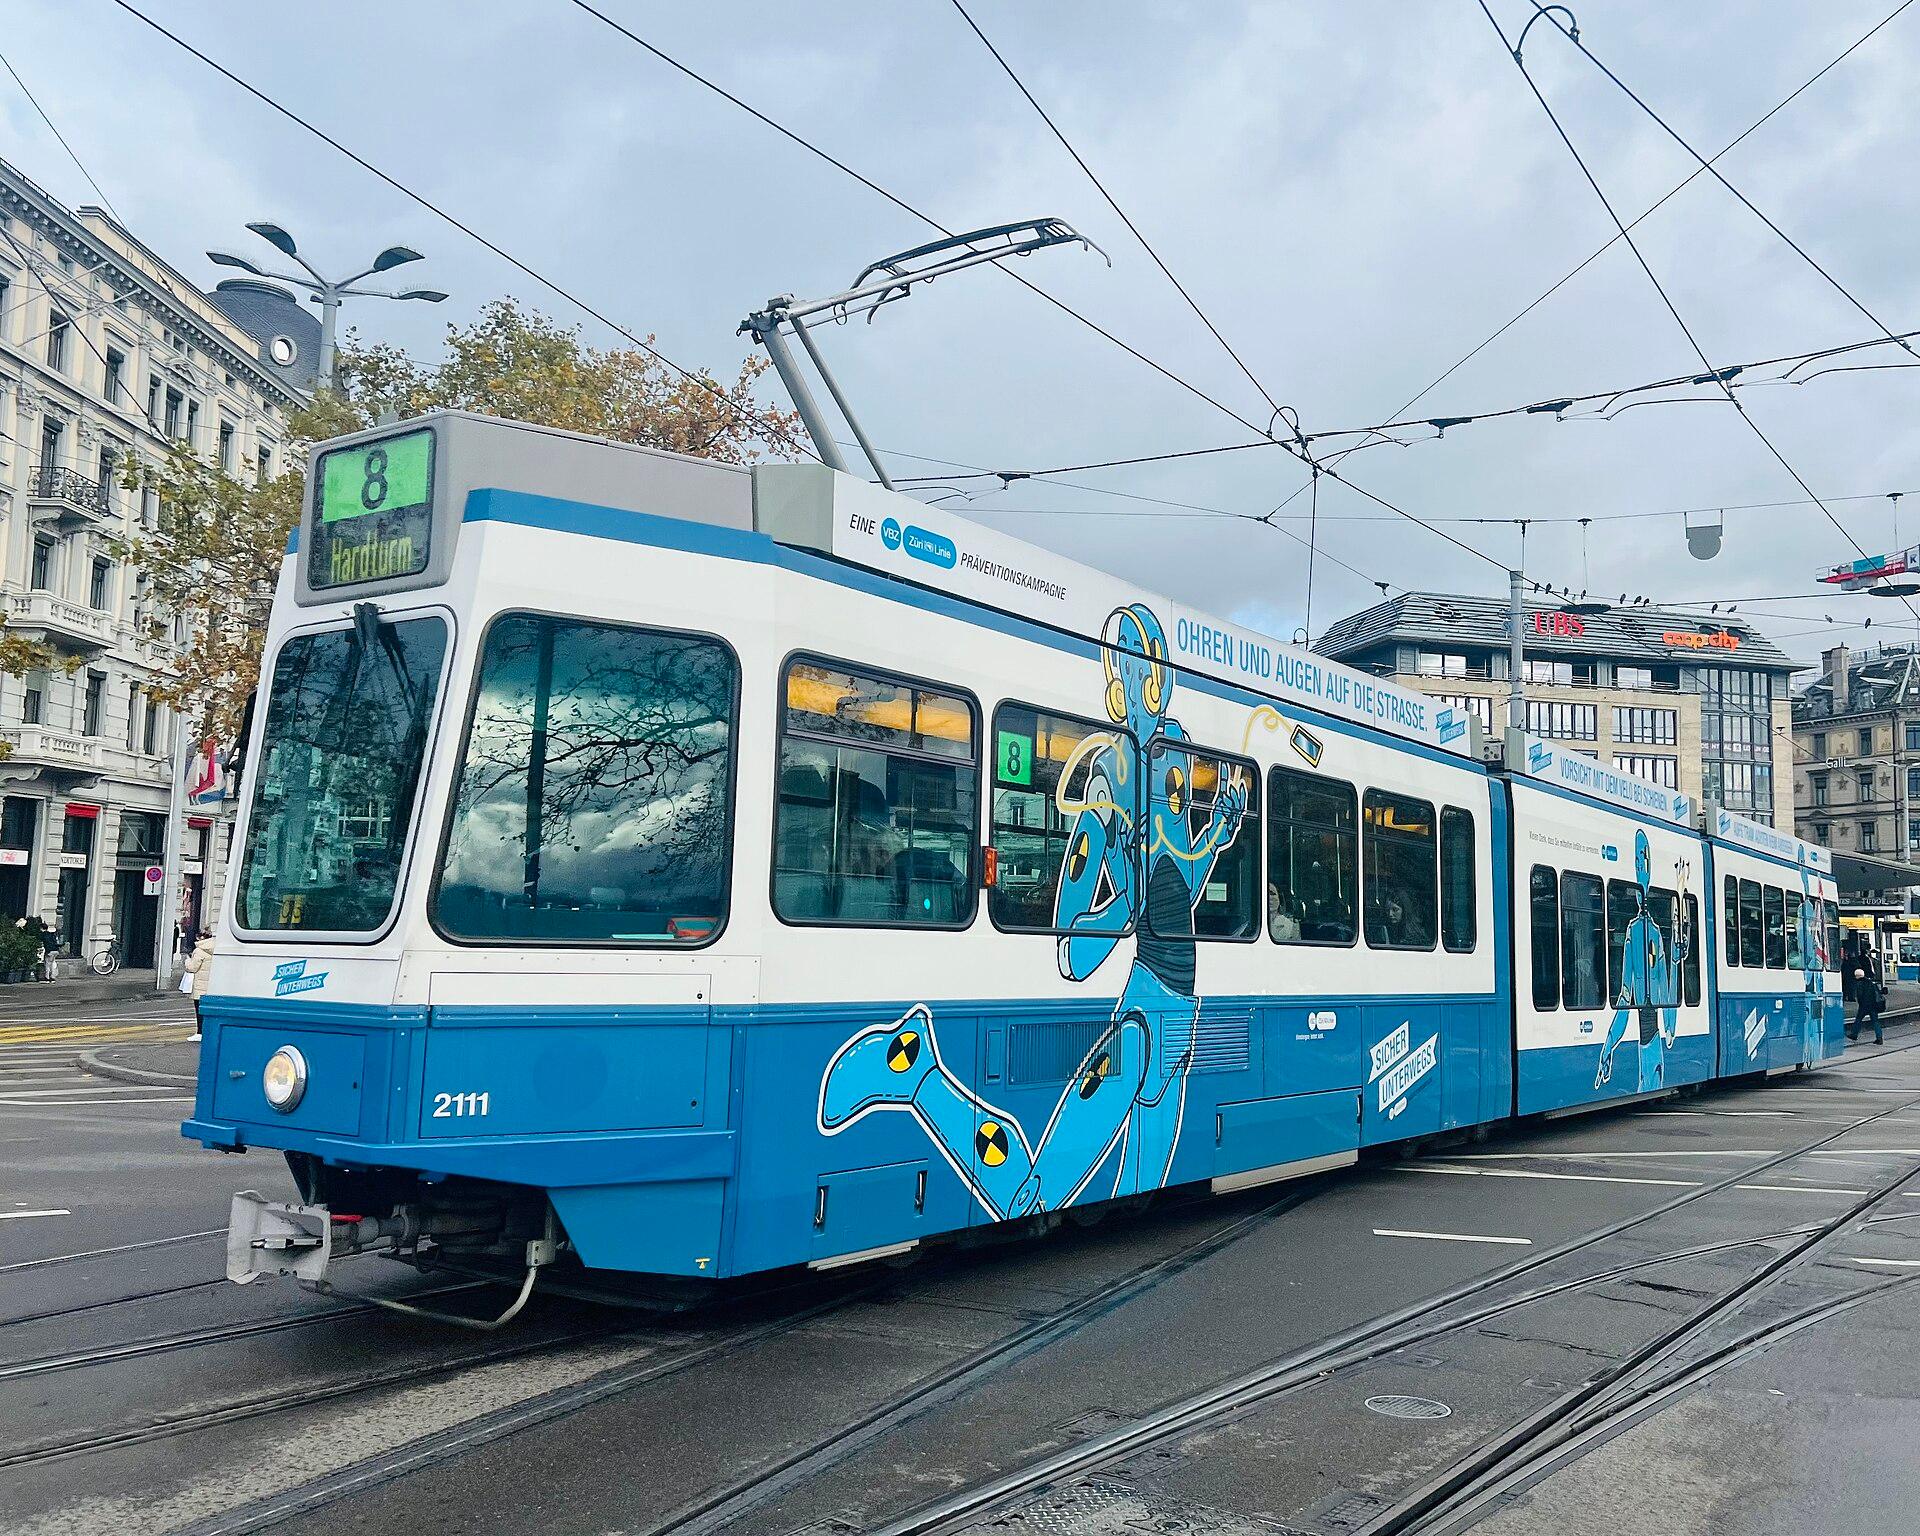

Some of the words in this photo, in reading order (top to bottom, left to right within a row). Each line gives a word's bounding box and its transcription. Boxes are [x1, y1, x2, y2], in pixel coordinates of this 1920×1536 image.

[361, 450, 388, 510] 8
[331, 530, 412, 583] Hardturm
[850, 513, 876, 535] EINE
[883, 526, 900, 542] VBZ
[908, 535, 924, 549] Züri
[934, 543, 952, 560] Linie
[960, 552, 1067, 601] PRÄVENTIONSKAMPAGNE
[1535, 611, 1585, 638] UBS
[1662, 631, 1710, 650] coop
[1708, 631, 1740, 653] city
[1177, 617, 1234, 667] OHREN
[1239, 640, 1271, 678] UND
[1275, 653, 1322, 697] AUGEN
[1326, 671, 1350, 705] AUF
[1354, 681, 1374, 714] DIE
[1376, 690, 1428, 732] STRASSE.
[1008, 741, 1020, 776] 8
[1561, 757, 1592, 786] VORSICHT
[277, 975, 323, 995] UNTERWEGS
[278, 962, 305, 978] SICHER
[1375, 1029, 1407, 1071] SICHER
[1382, 1044, 1432, 1104] UNTERWEGS
[432, 1092, 489, 1118] 2111
